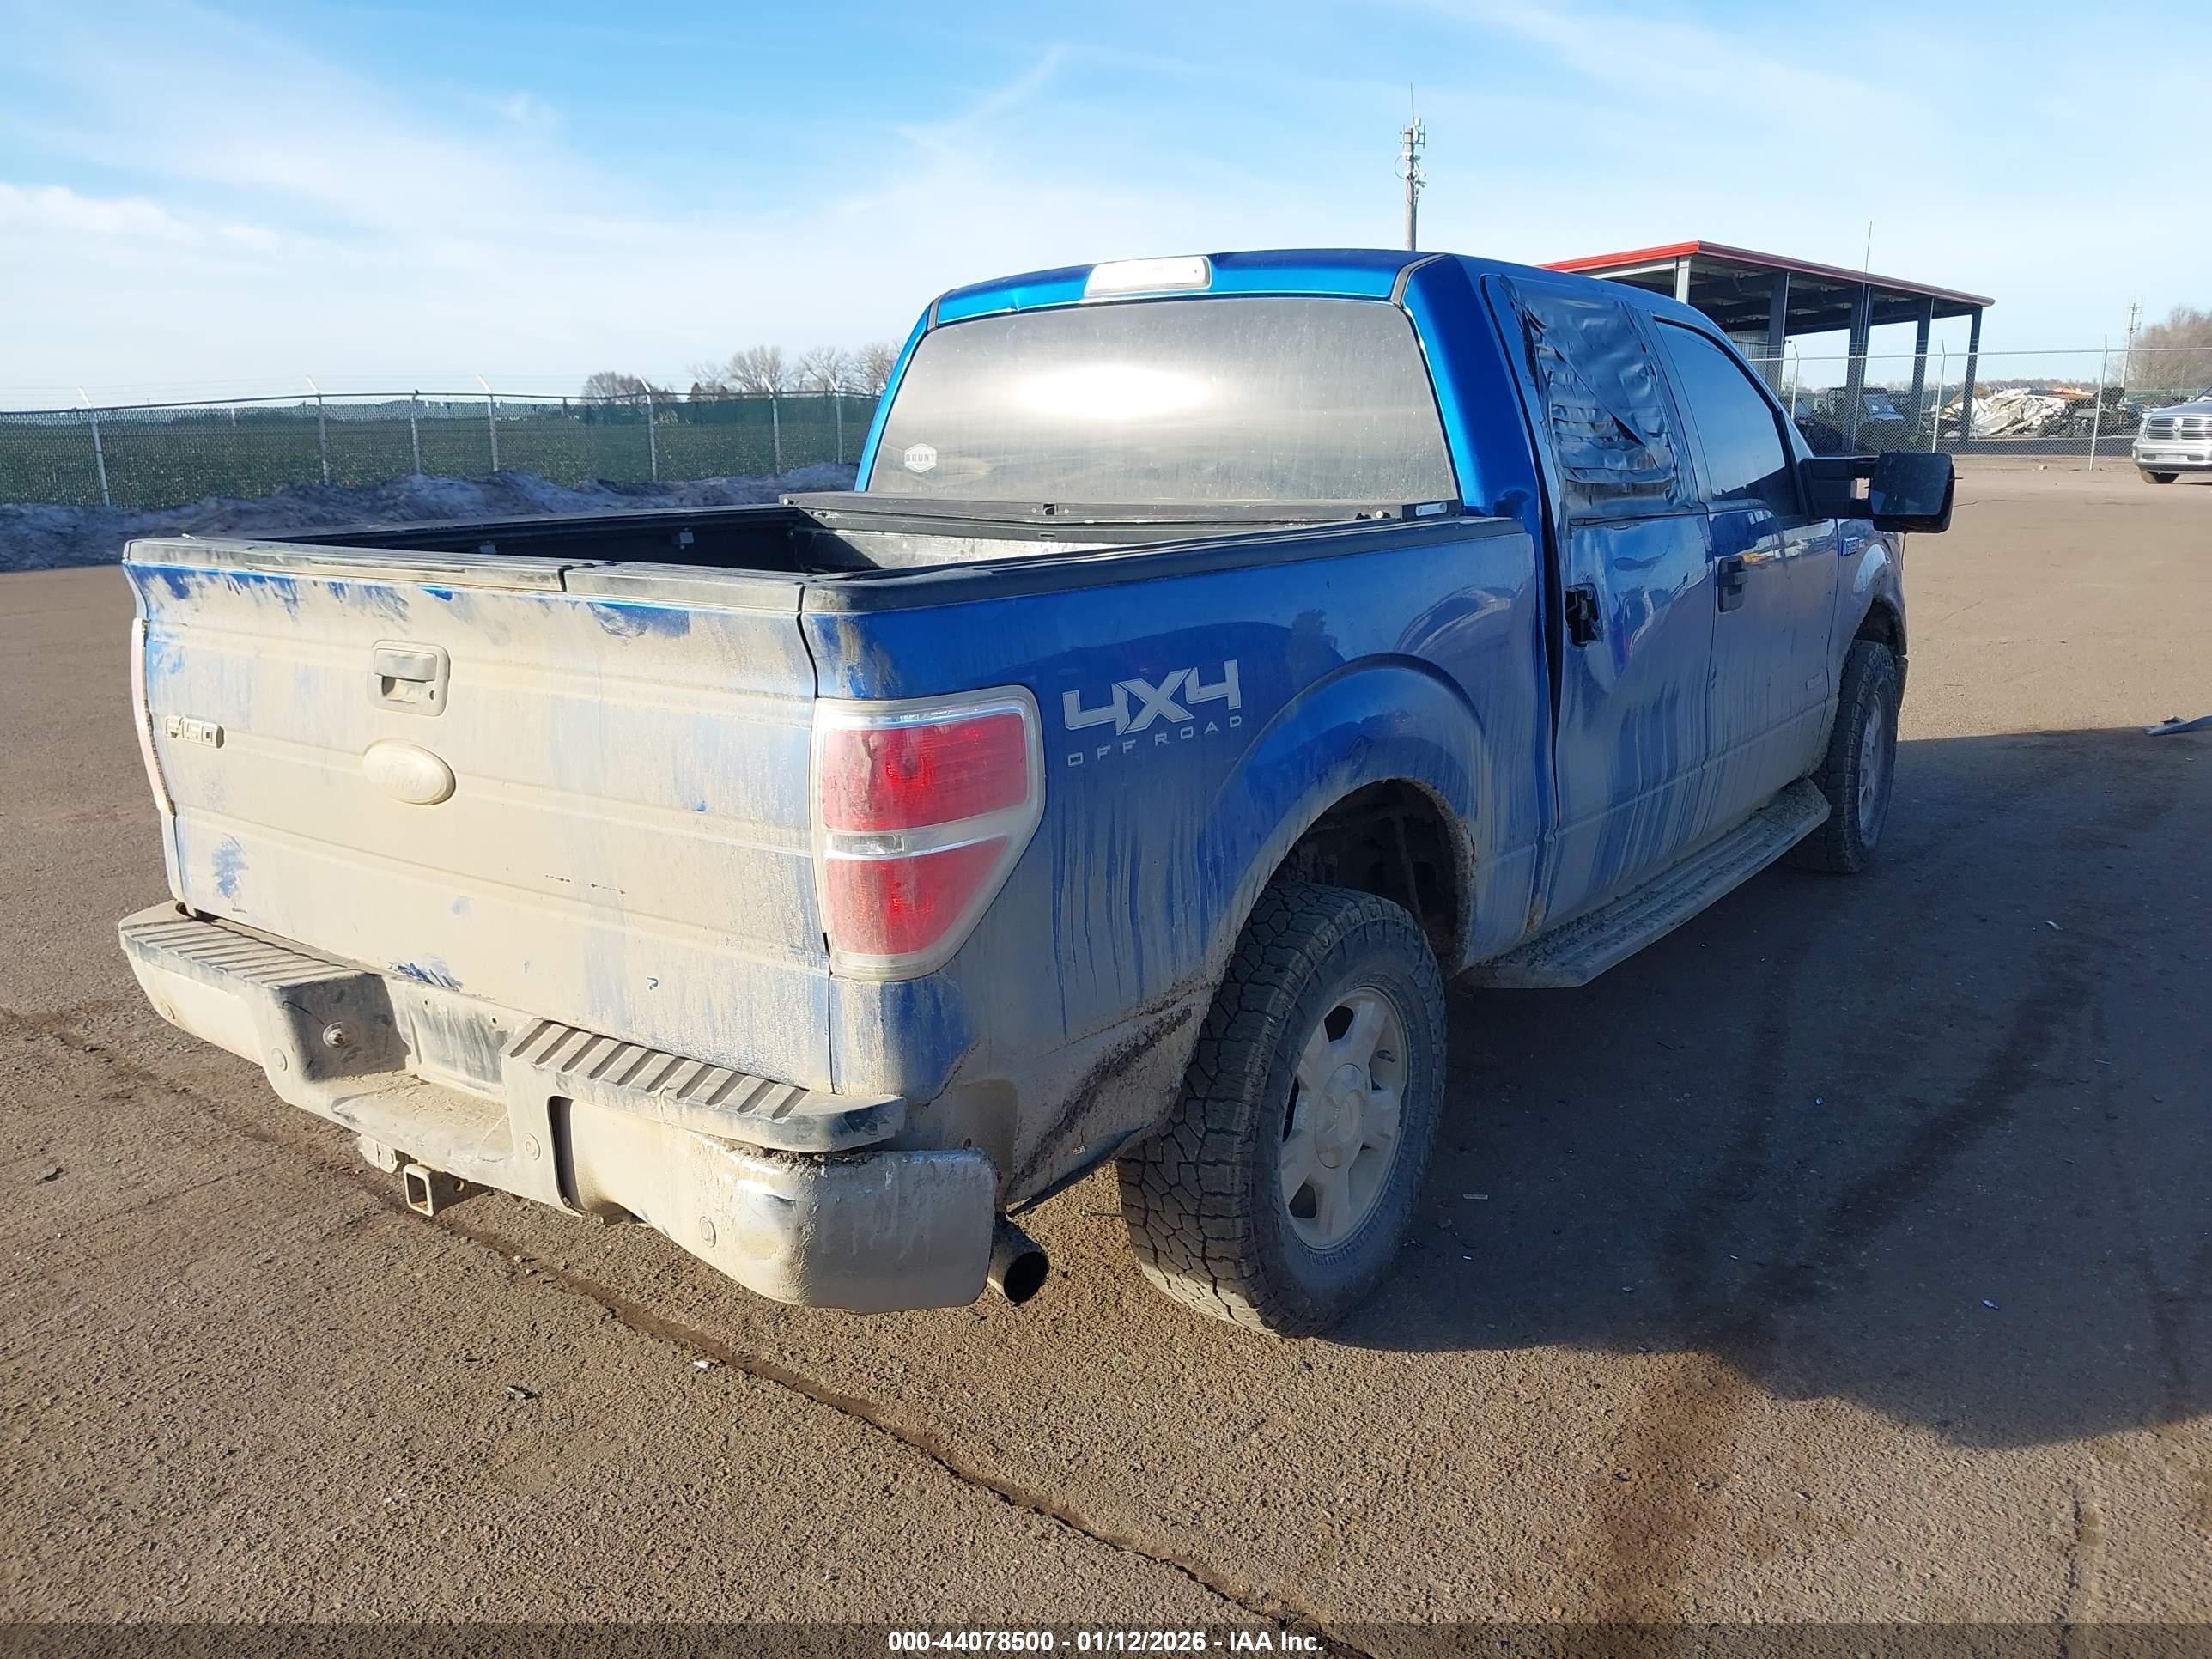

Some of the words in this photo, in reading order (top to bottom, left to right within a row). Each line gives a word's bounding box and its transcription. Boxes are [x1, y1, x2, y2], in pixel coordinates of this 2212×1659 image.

[1062, 659, 1242, 736] 4X4
[1067, 739, 1137, 768] OFF
[1154, 714, 1243, 747] ROAD
